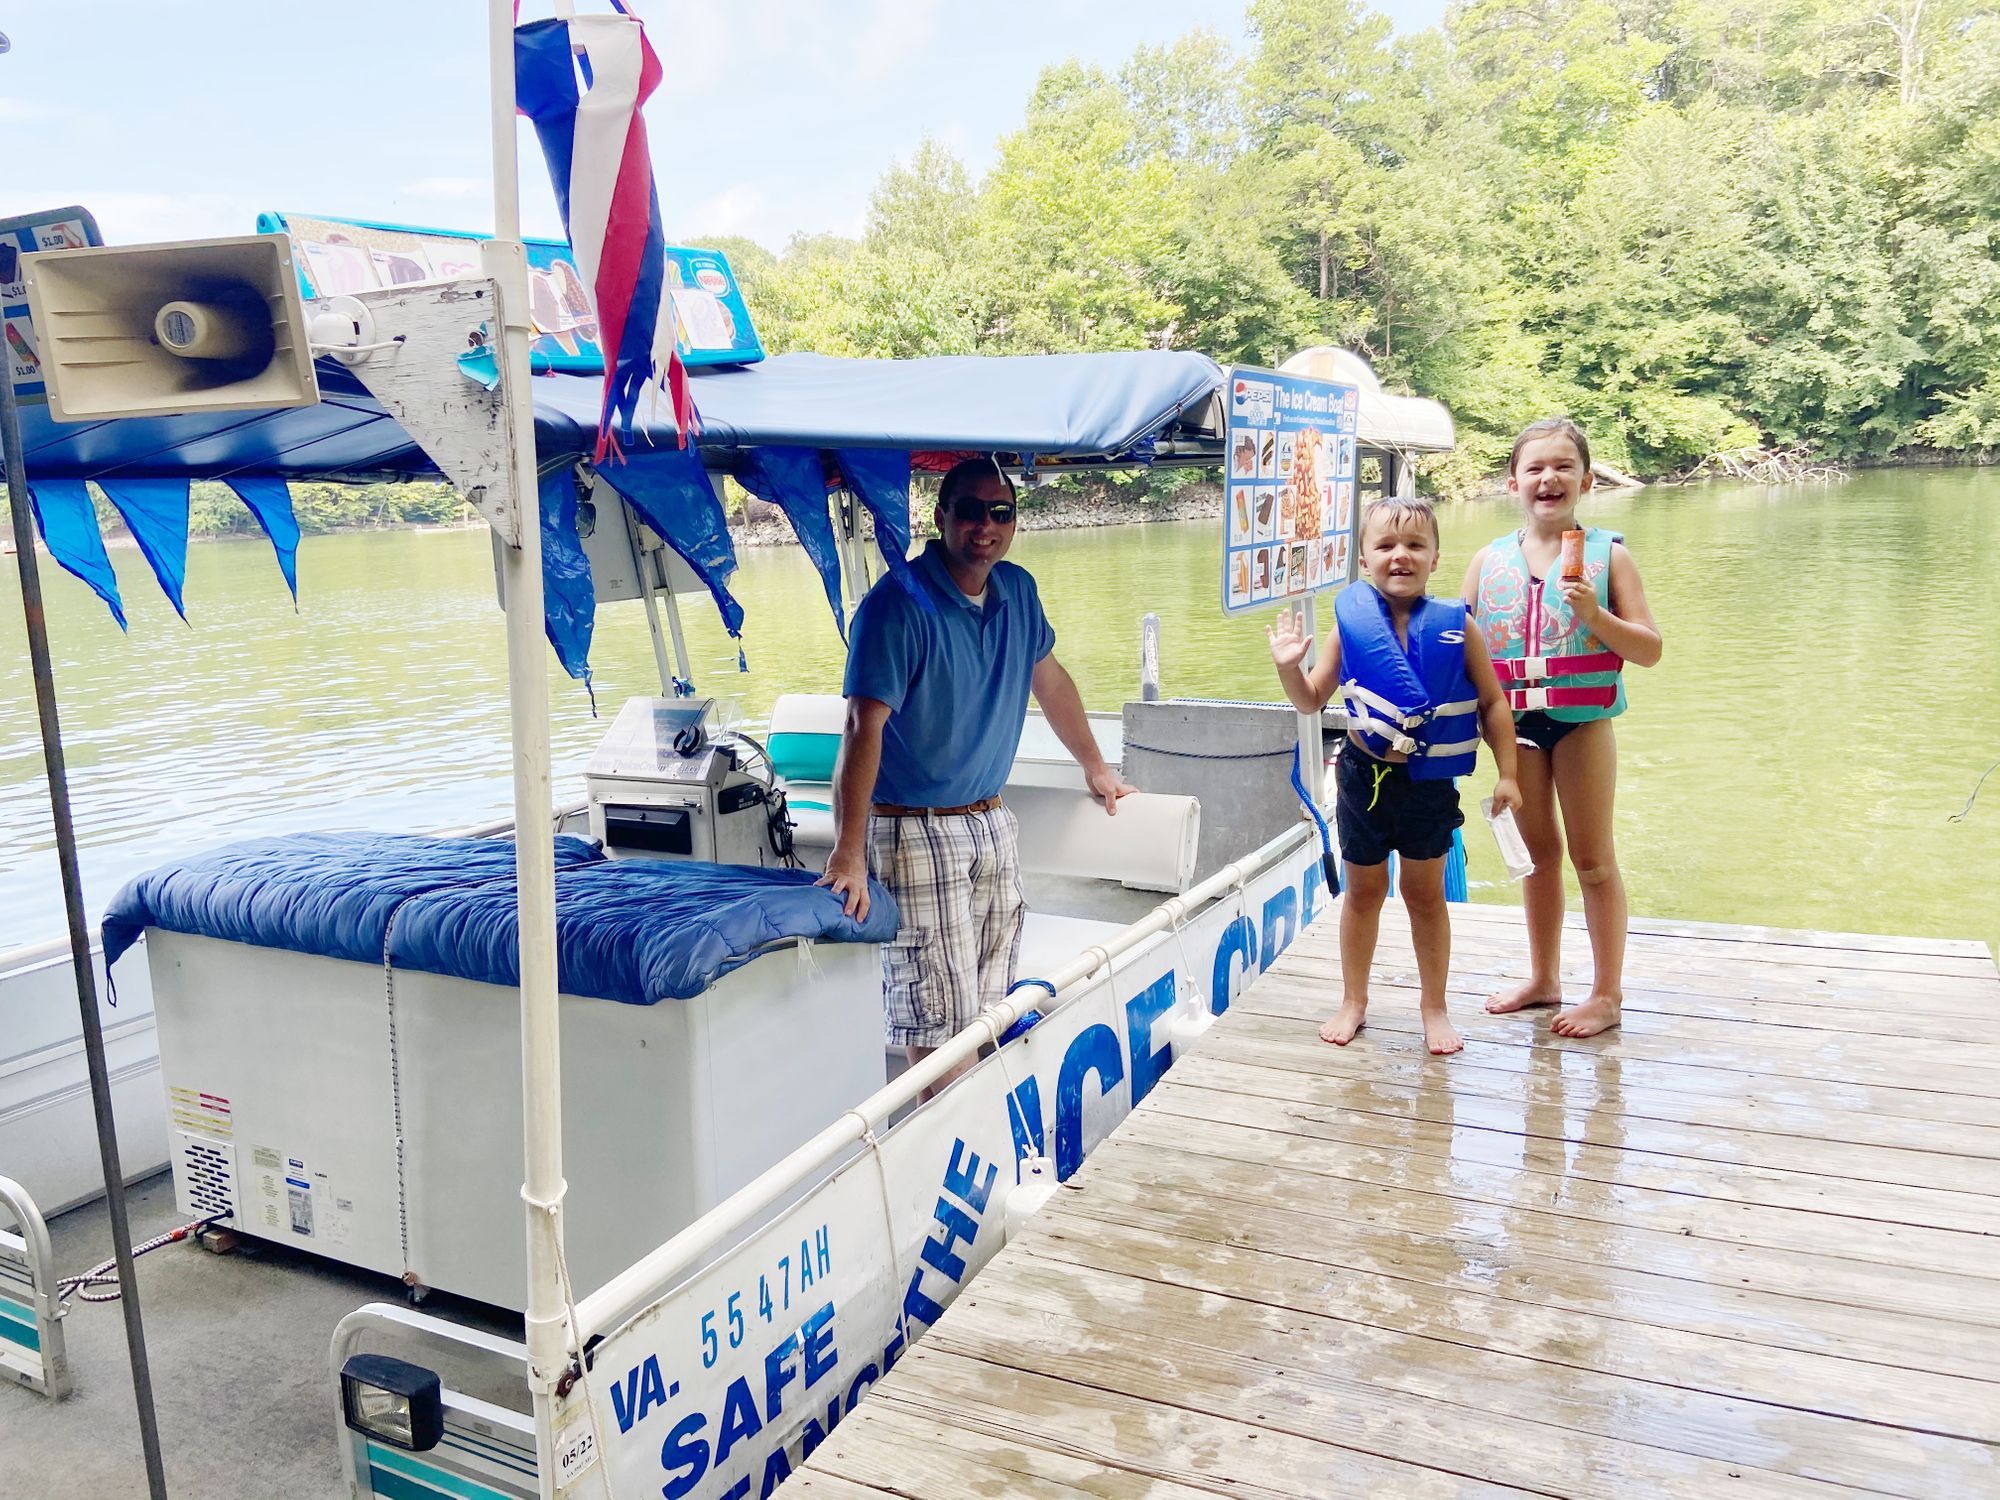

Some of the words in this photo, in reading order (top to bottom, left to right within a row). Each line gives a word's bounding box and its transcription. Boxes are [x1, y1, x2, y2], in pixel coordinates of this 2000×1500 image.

[42, 234, 64, 248] $1.00
[16, 365, 36, 377] $1.00
[1246, 389, 1272, 403] PEPSI
[1275, 386, 1289, 409] The
[1291, 388, 1303, 410] Ice
[1304, 390, 1327, 413] Cream
[1328, 393, 1344, 415] Boat
[895, 1137, 998, 1330] THE
[610, 1354, 680, 1434] VA.
[661, 1300, 839, 1499] SAFE
[563, 1435, 593, 1468] 05/22
